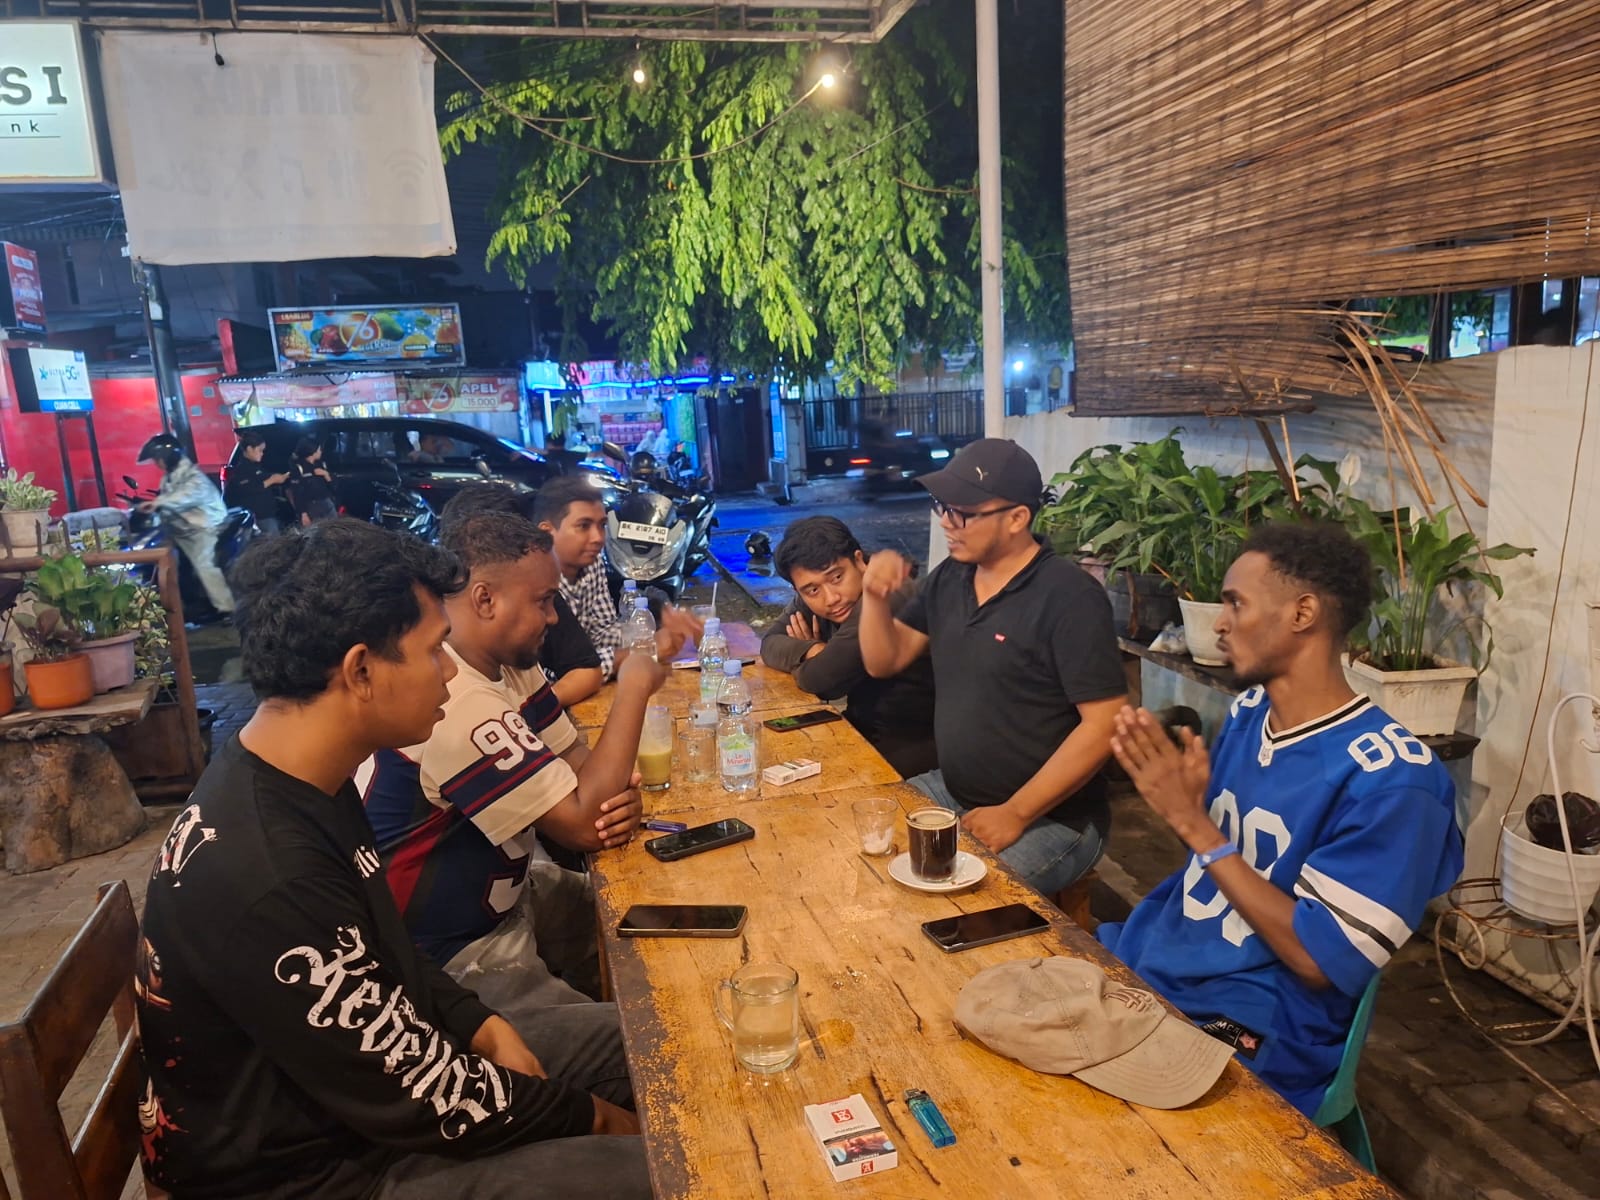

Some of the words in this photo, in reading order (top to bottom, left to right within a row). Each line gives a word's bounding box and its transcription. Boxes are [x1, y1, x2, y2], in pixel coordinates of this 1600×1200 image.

[0, 66, 67, 105] SI
[461, 383, 498, 394] APEL
[470, 709, 544, 773] 98
